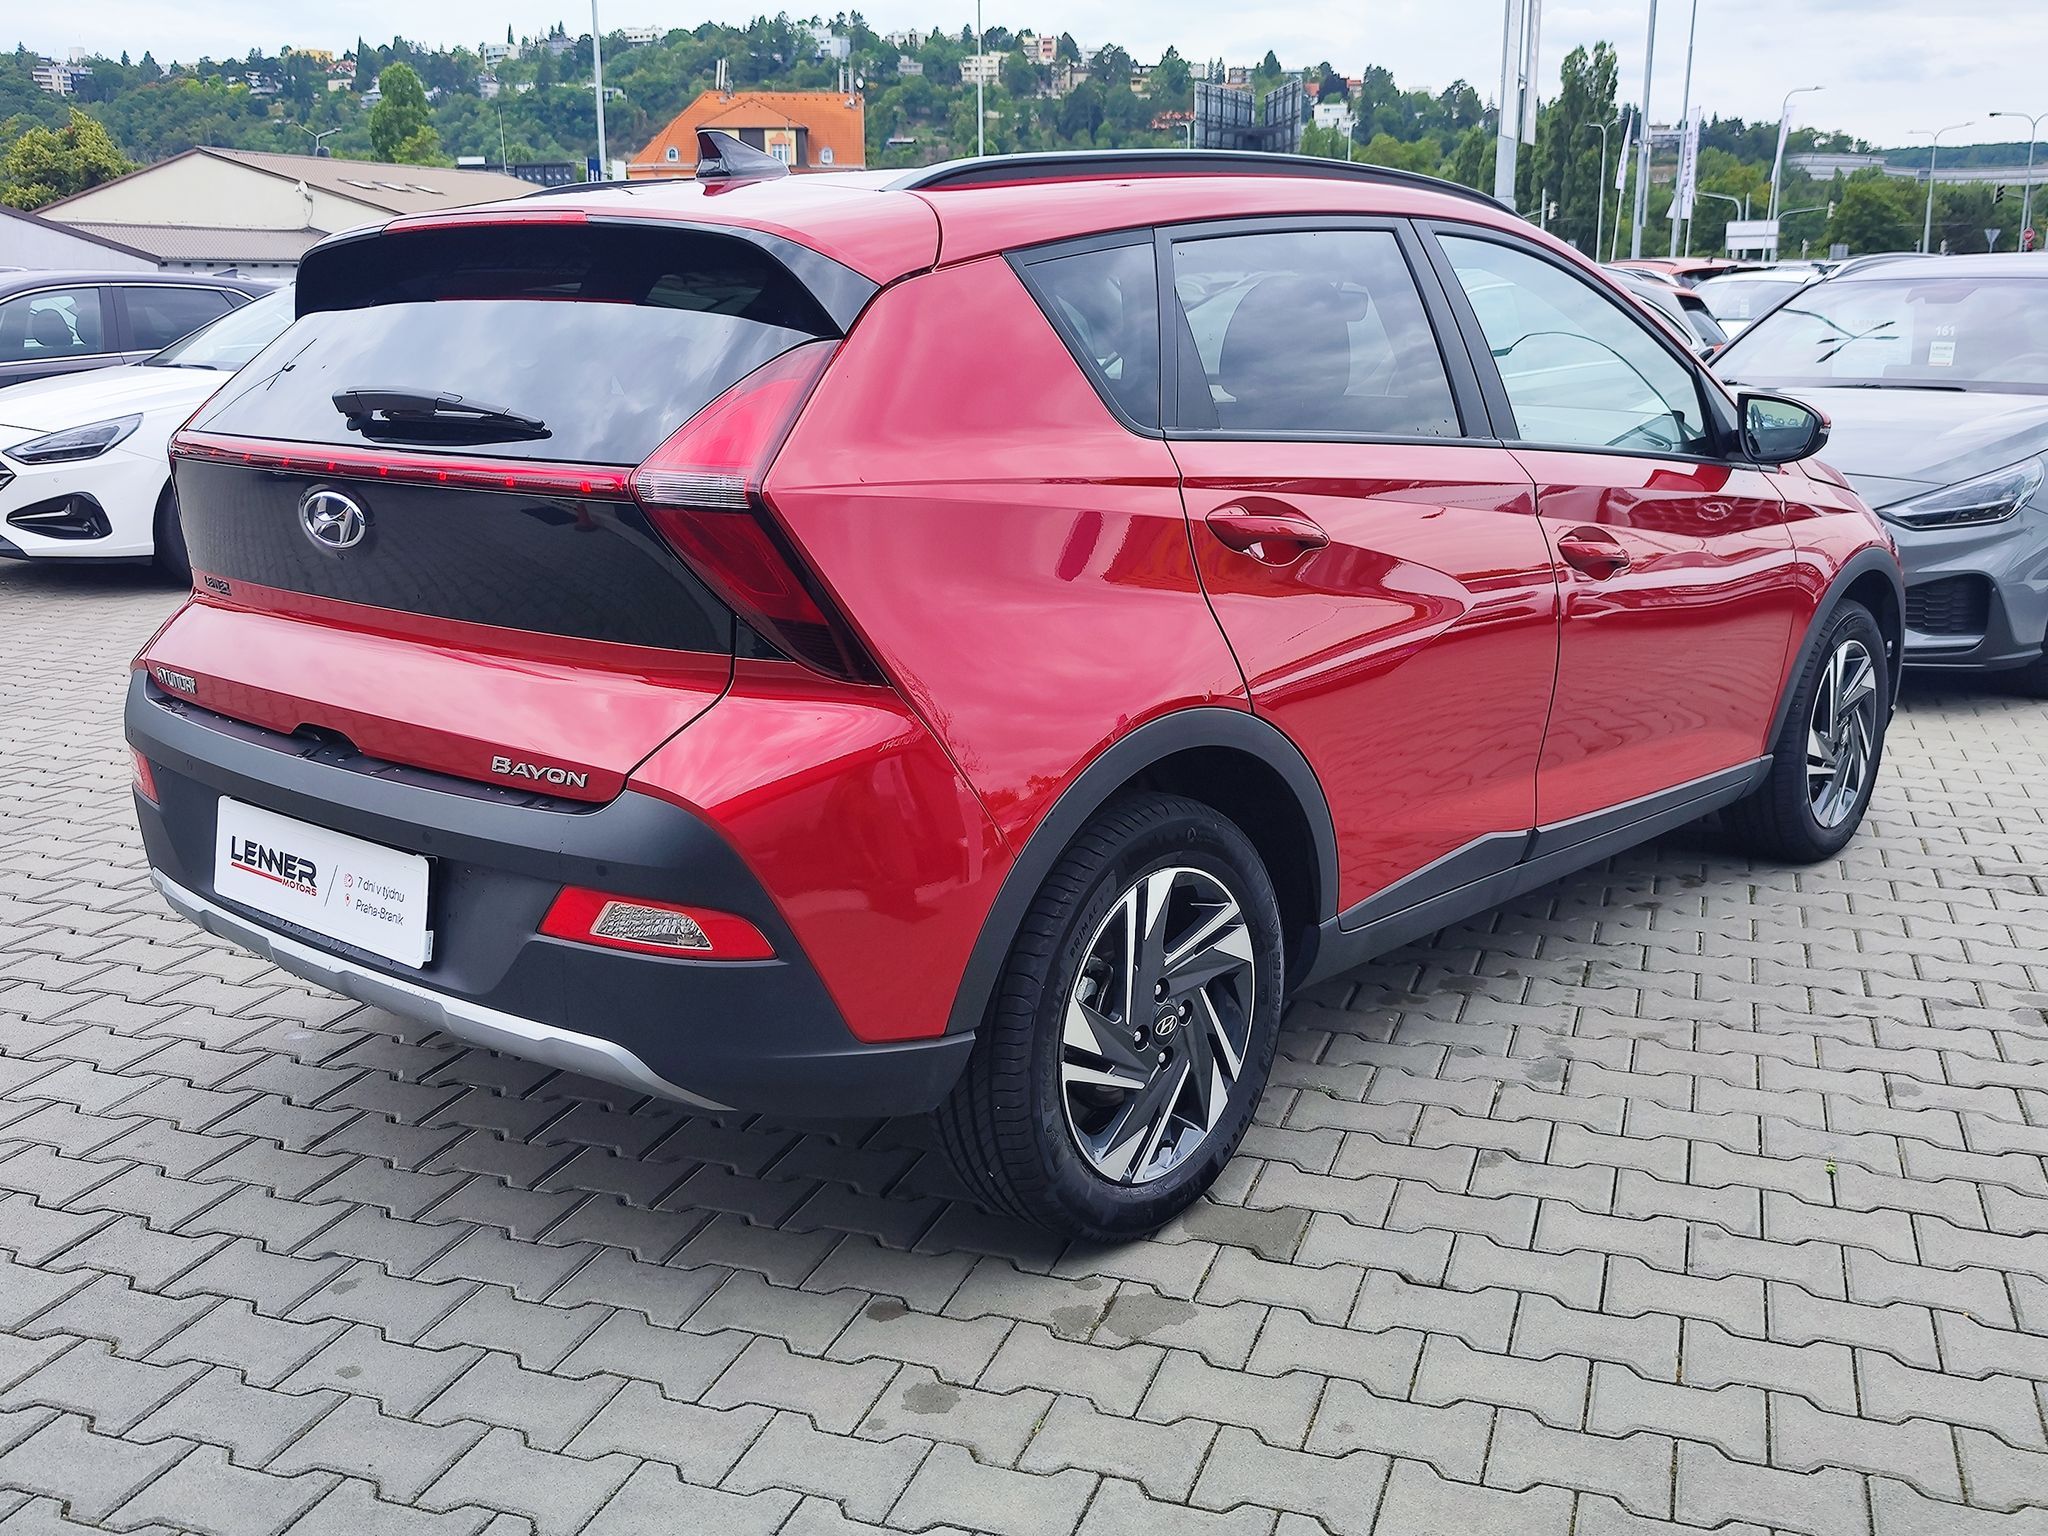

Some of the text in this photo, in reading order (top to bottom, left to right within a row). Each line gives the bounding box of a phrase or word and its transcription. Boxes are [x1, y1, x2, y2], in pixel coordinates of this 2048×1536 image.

[1936, 325, 1955, 337] 161
[491, 755, 588, 788] BAYON
[231, 835, 317, 888] LENNER
[282, 878, 317, 897] MOTORS
[357, 876, 363, 888] 7
